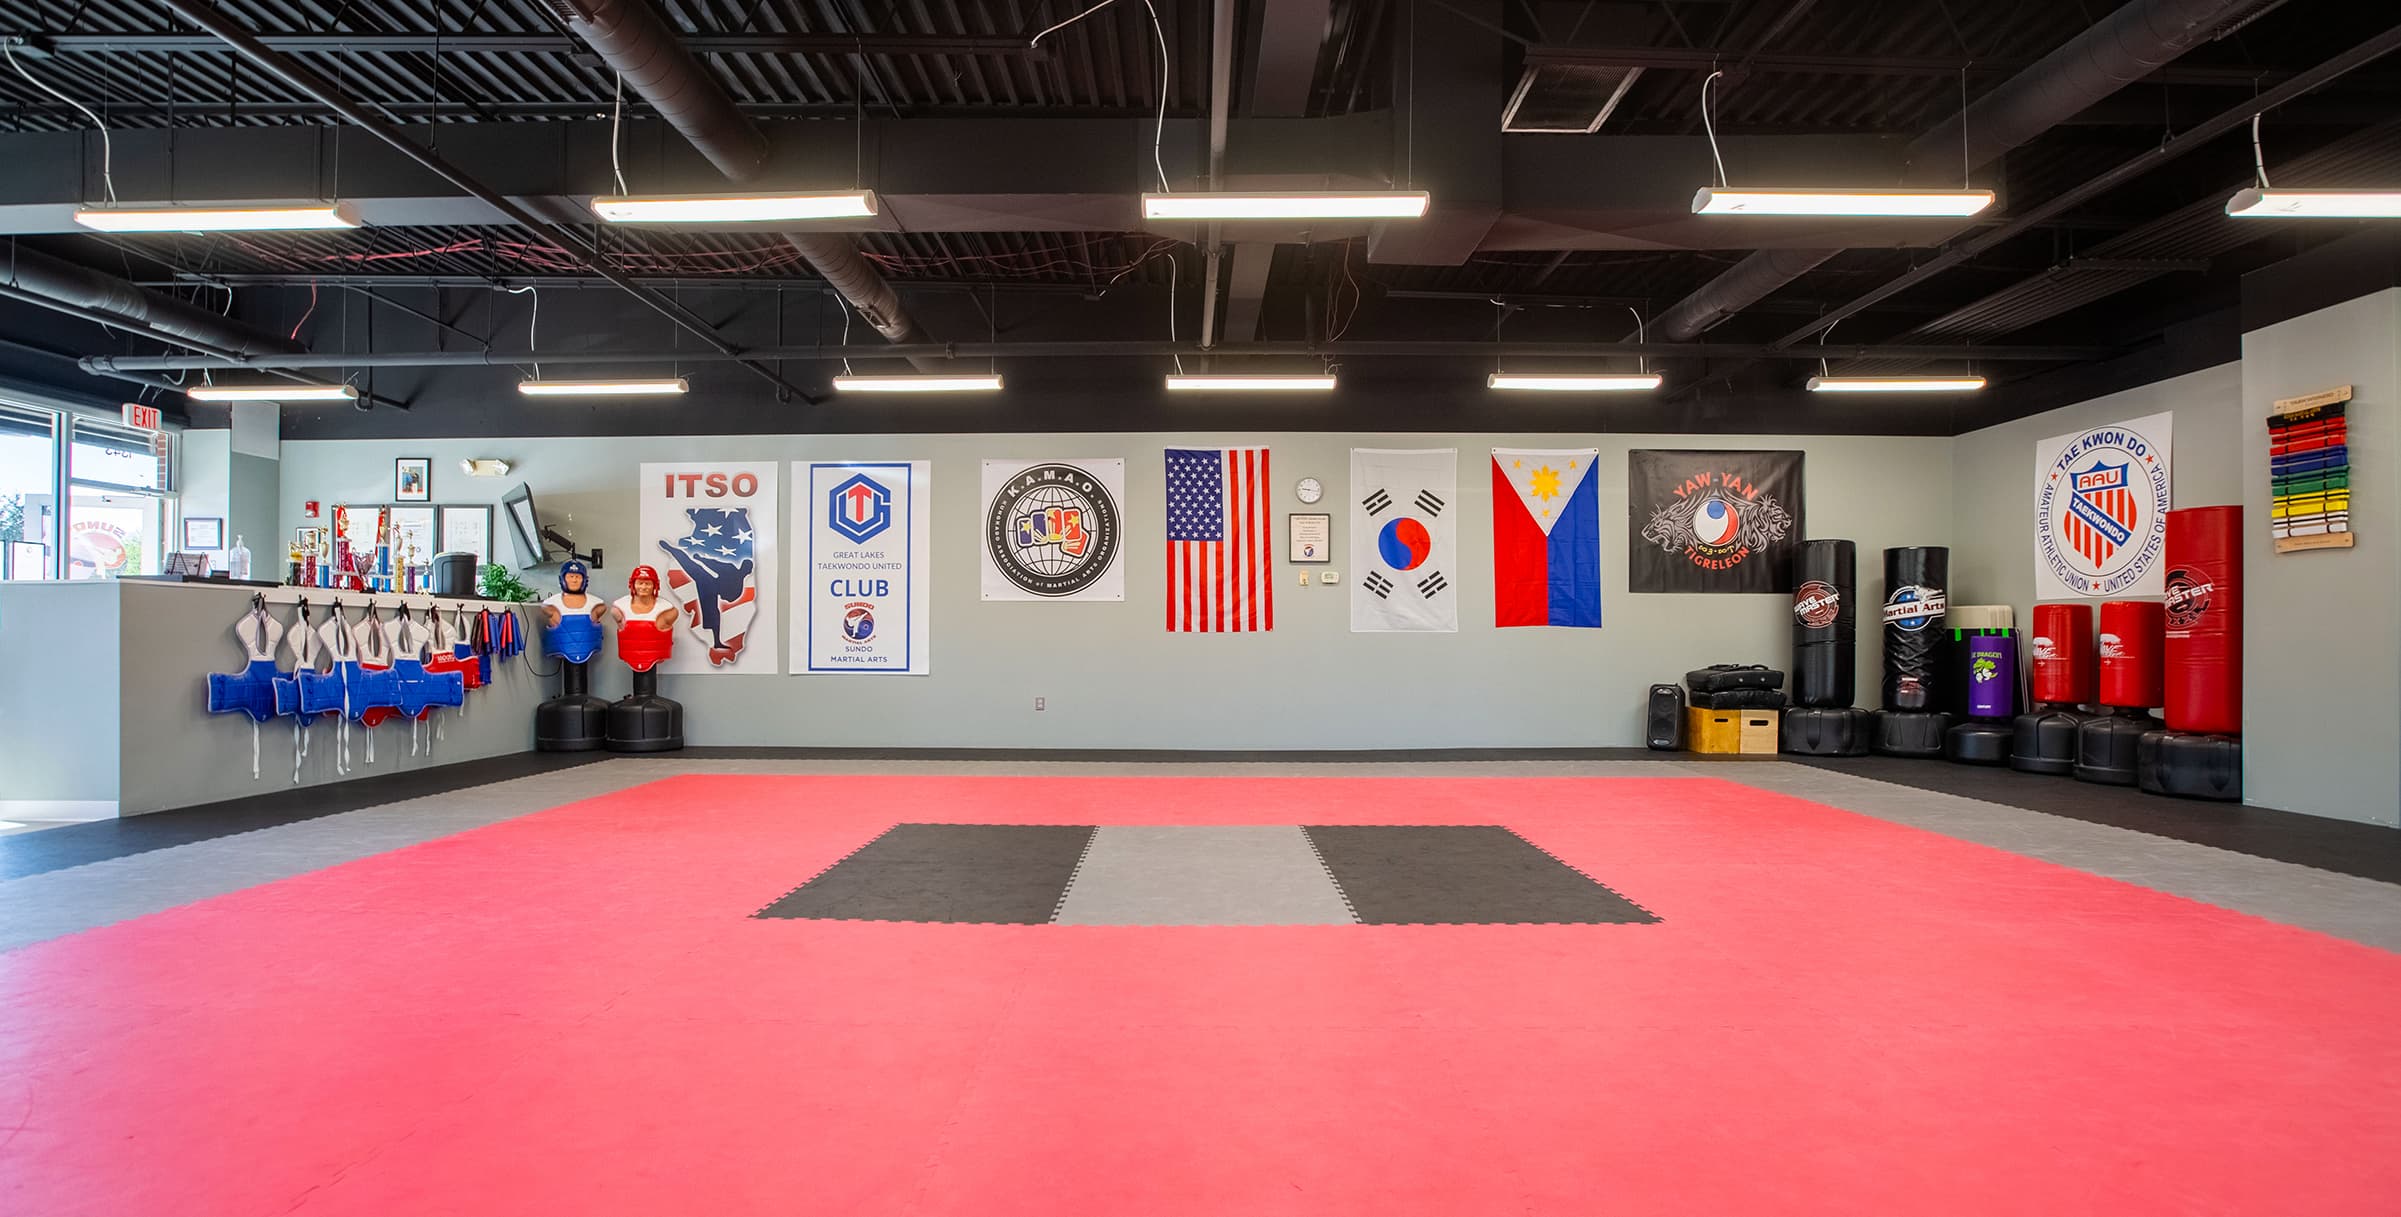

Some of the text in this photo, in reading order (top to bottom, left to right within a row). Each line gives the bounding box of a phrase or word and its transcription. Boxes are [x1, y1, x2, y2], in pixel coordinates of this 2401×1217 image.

[133, 405, 158, 430] EXIT
[2057, 432, 2146, 470] TAE KWON DO
[665, 473, 758, 498] ITSO
[2079, 470, 2119, 488] AAU
[2072, 497, 2125, 542] TAEKWONDO
[2104, 464, 2167, 592] UNITED STATES OF AMERICA
[2039, 483, 2089, 592] AMATEUR ATHLETIC UNION
[818, 562, 902, 571] TAEKWONDO UNITED
[833, 551, 885, 559] GREAT LAKES
[1684, 545, 1750, 570] TIGRELEON
[1046, 577, 1080, 588] MARTIAL
[1082, 562, 1098, 578] ARTS
[830, 579, 889, 597] CLUB
[2165, 583, 2214, 609] ASTER
[1923, 603, 1945, 611] Arts
